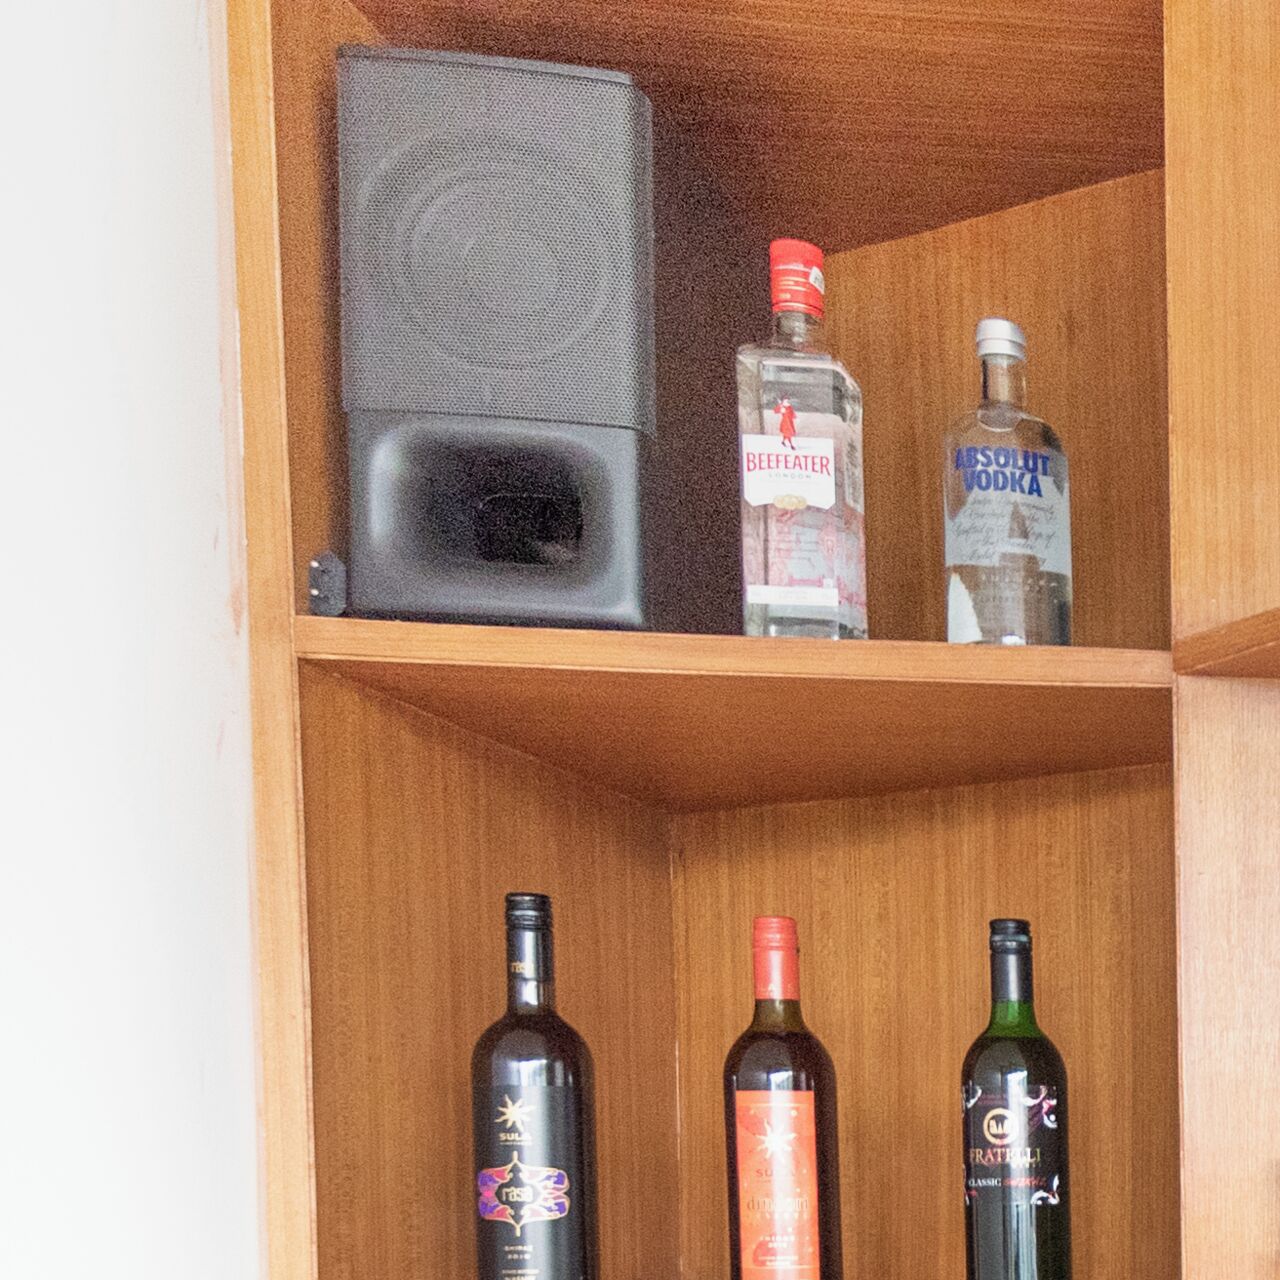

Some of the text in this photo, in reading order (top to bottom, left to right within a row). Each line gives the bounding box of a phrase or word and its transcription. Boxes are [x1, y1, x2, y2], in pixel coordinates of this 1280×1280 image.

[746, 452, 831, 476] BEEFEATER
[956, 446, 1050, 476] ABSOLUT
[962, 468, 1043, 497] VODKA
[499, 1132, 531, 1141] SULA
[968, 1178, 1002, 1188] CLASSIC
[502, 1187, 533, 1202] rasa
